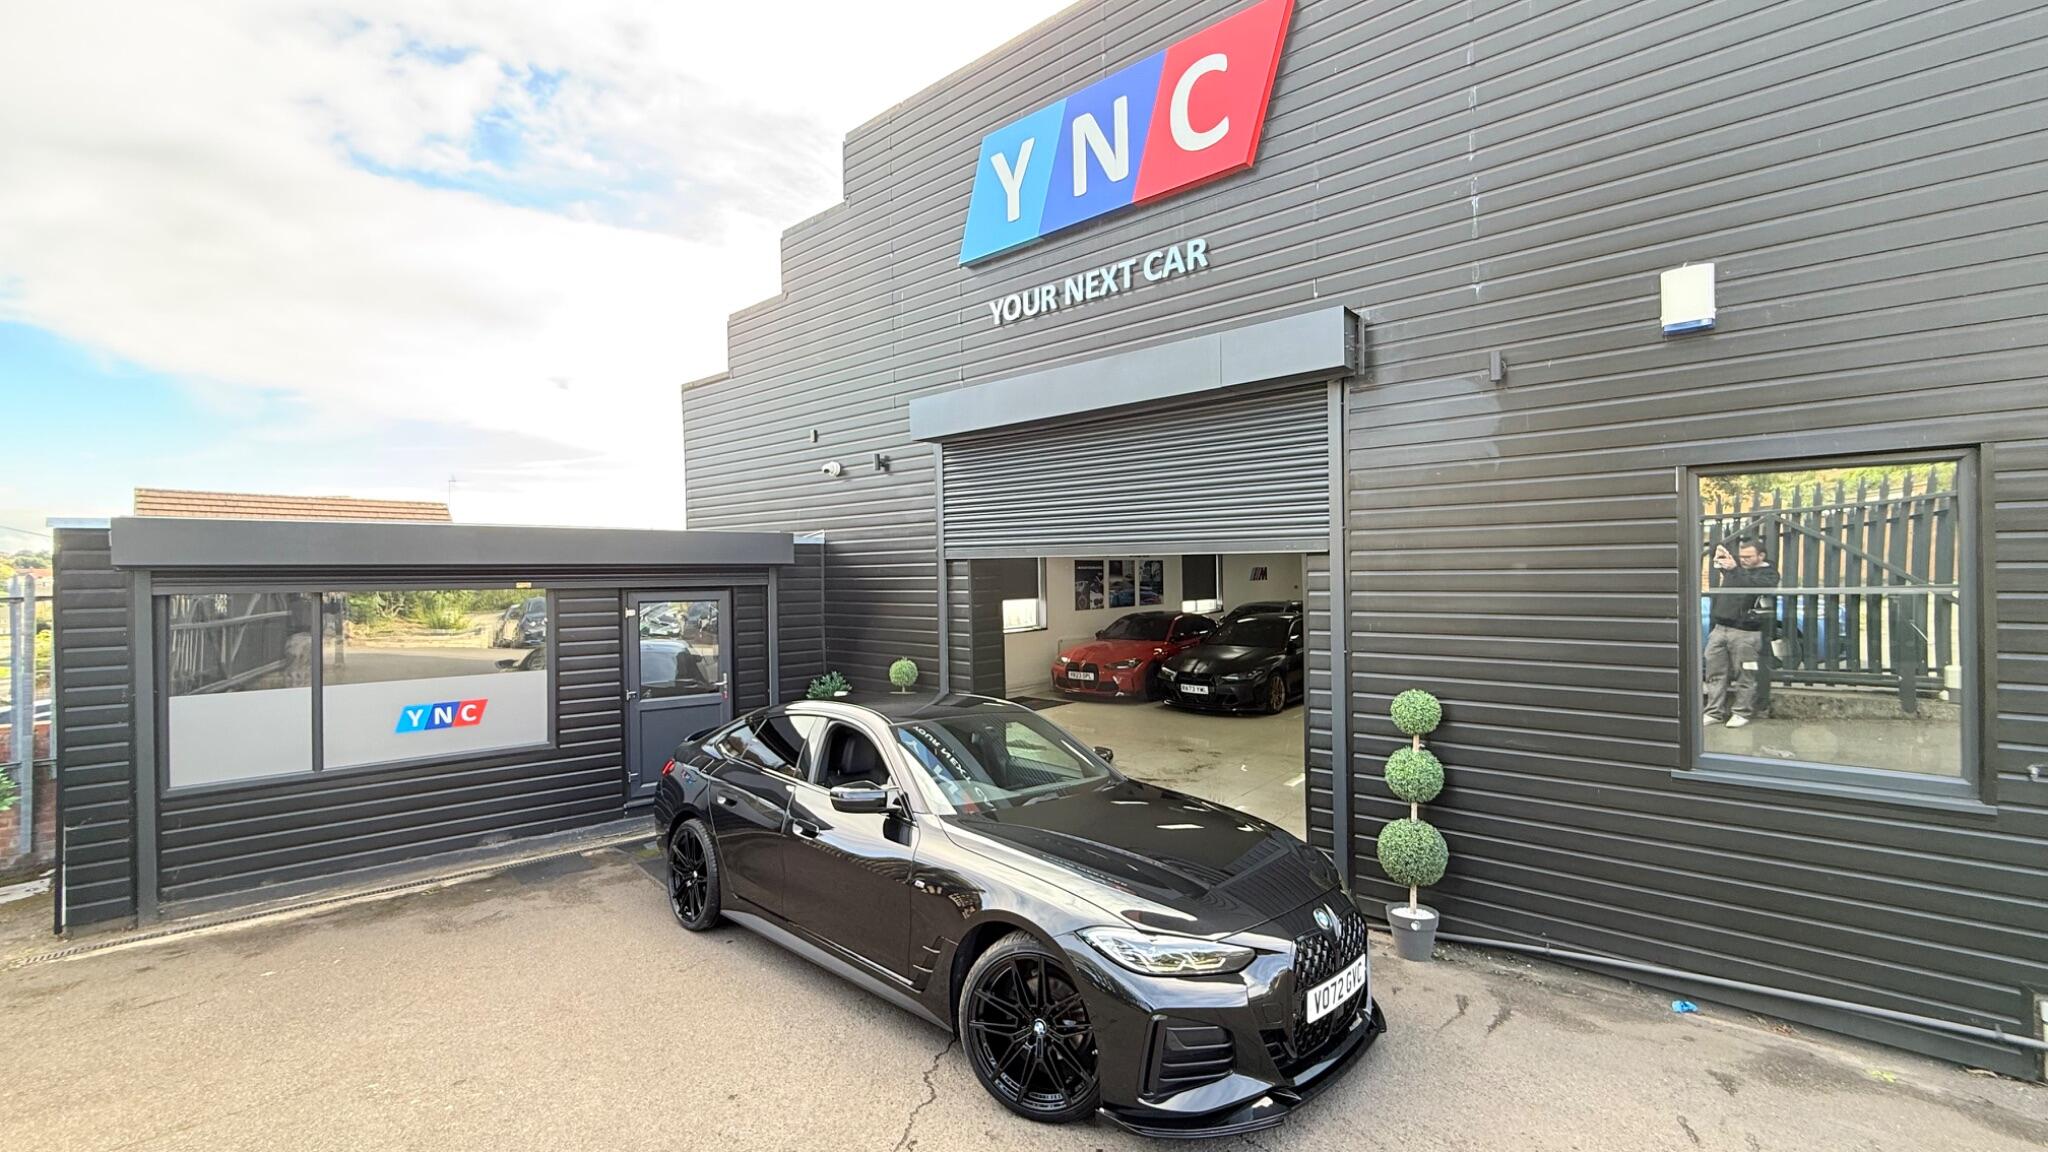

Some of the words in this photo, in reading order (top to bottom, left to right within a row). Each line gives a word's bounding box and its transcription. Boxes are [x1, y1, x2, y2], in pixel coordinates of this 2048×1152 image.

[990, 53, 1230, 222] YNC
[989, 283, 1058, 326] YOUR
[1064, 258, 1137, 306] NEXT
[1143, 237, 1209, 282] CAR
[406, 704, 478, 728] YNC
[1314, 976, 1344, 1015] VO72
[1346, 961, 1363, 994] GVC
